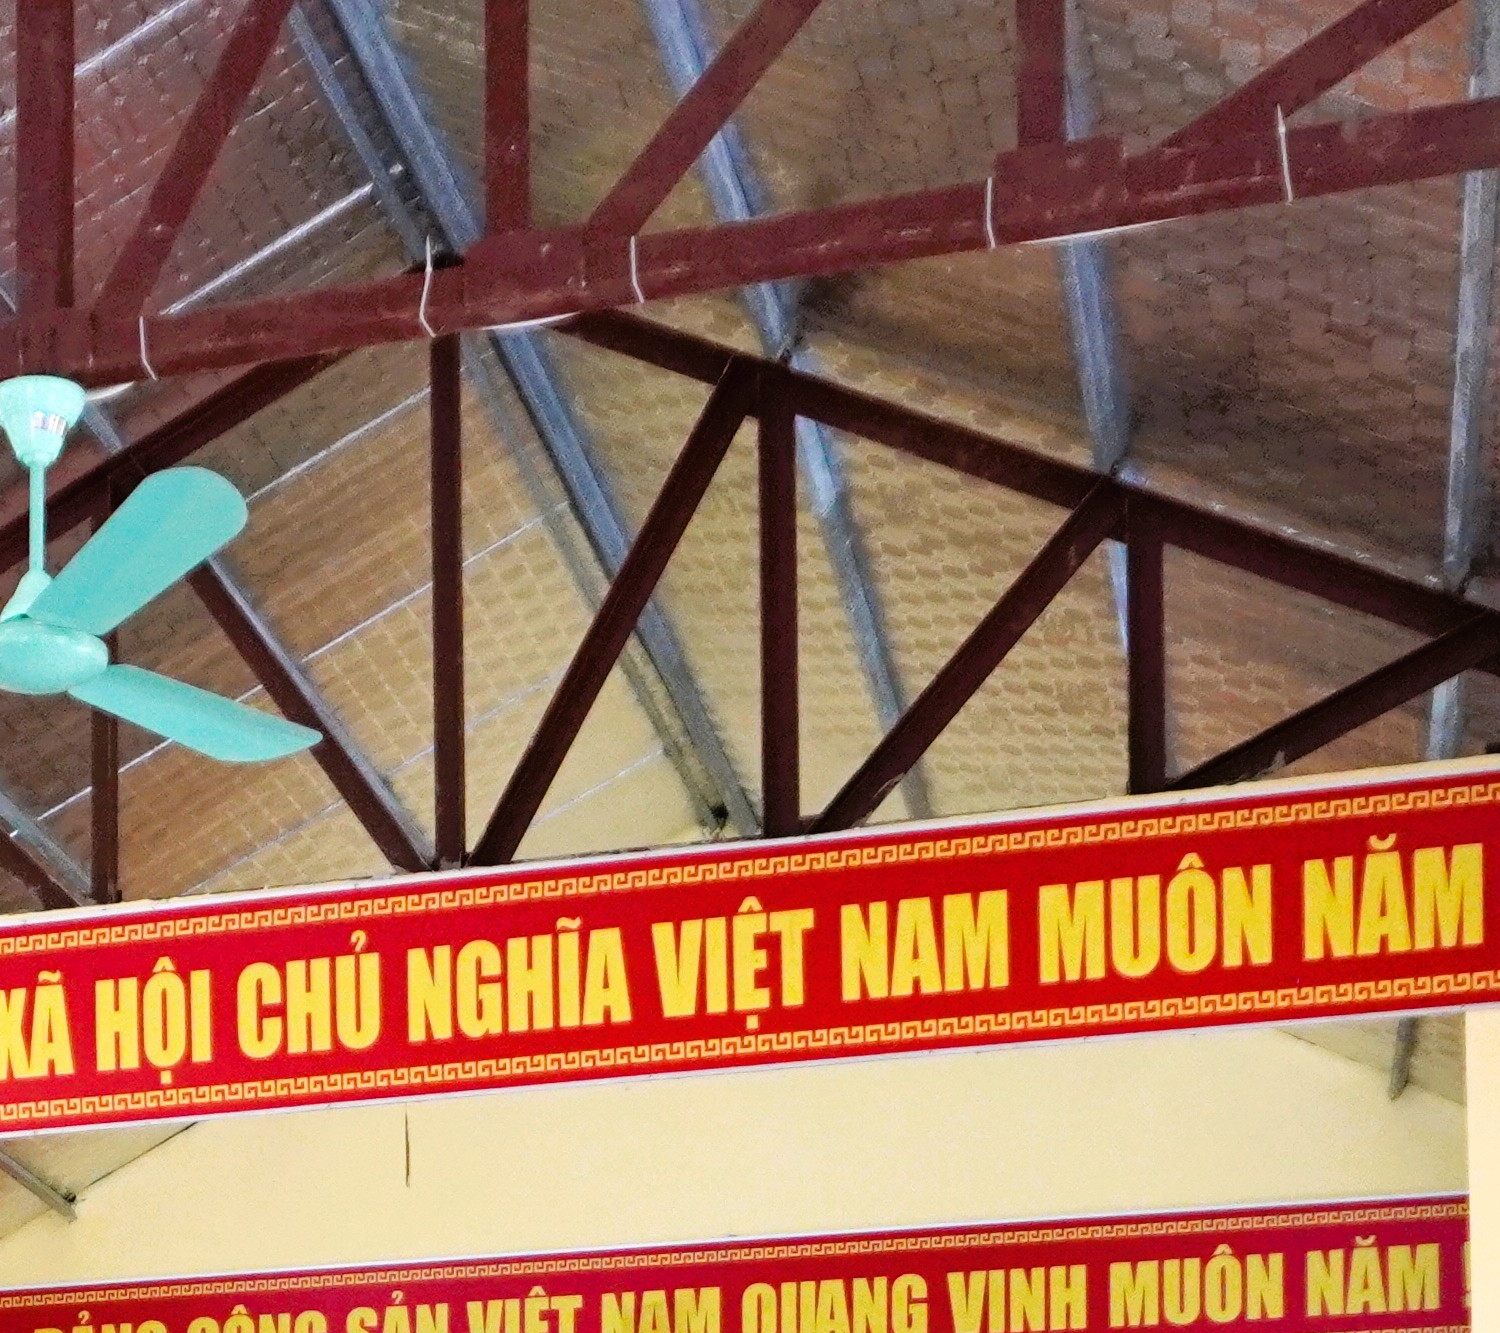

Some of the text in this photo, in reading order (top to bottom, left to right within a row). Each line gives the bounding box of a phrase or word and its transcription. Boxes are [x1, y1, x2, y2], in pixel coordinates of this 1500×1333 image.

[94, 955, 212, 1086] HỘI
[236, 929, 382, 1060] CHỦ
[406, 917, 632, 1043] NGHĨA
[657, 894, 815, 1033] VIỆT
[838, 888, 1011, 1002] NAM
[1037, 854, 1275, 985] MUÔN
[1300, 836, 1485, 960] NĂM
[1107, 1243, 1286, 1329] MUÔN
[1304, 1235, 1442, 1318] NĂM
